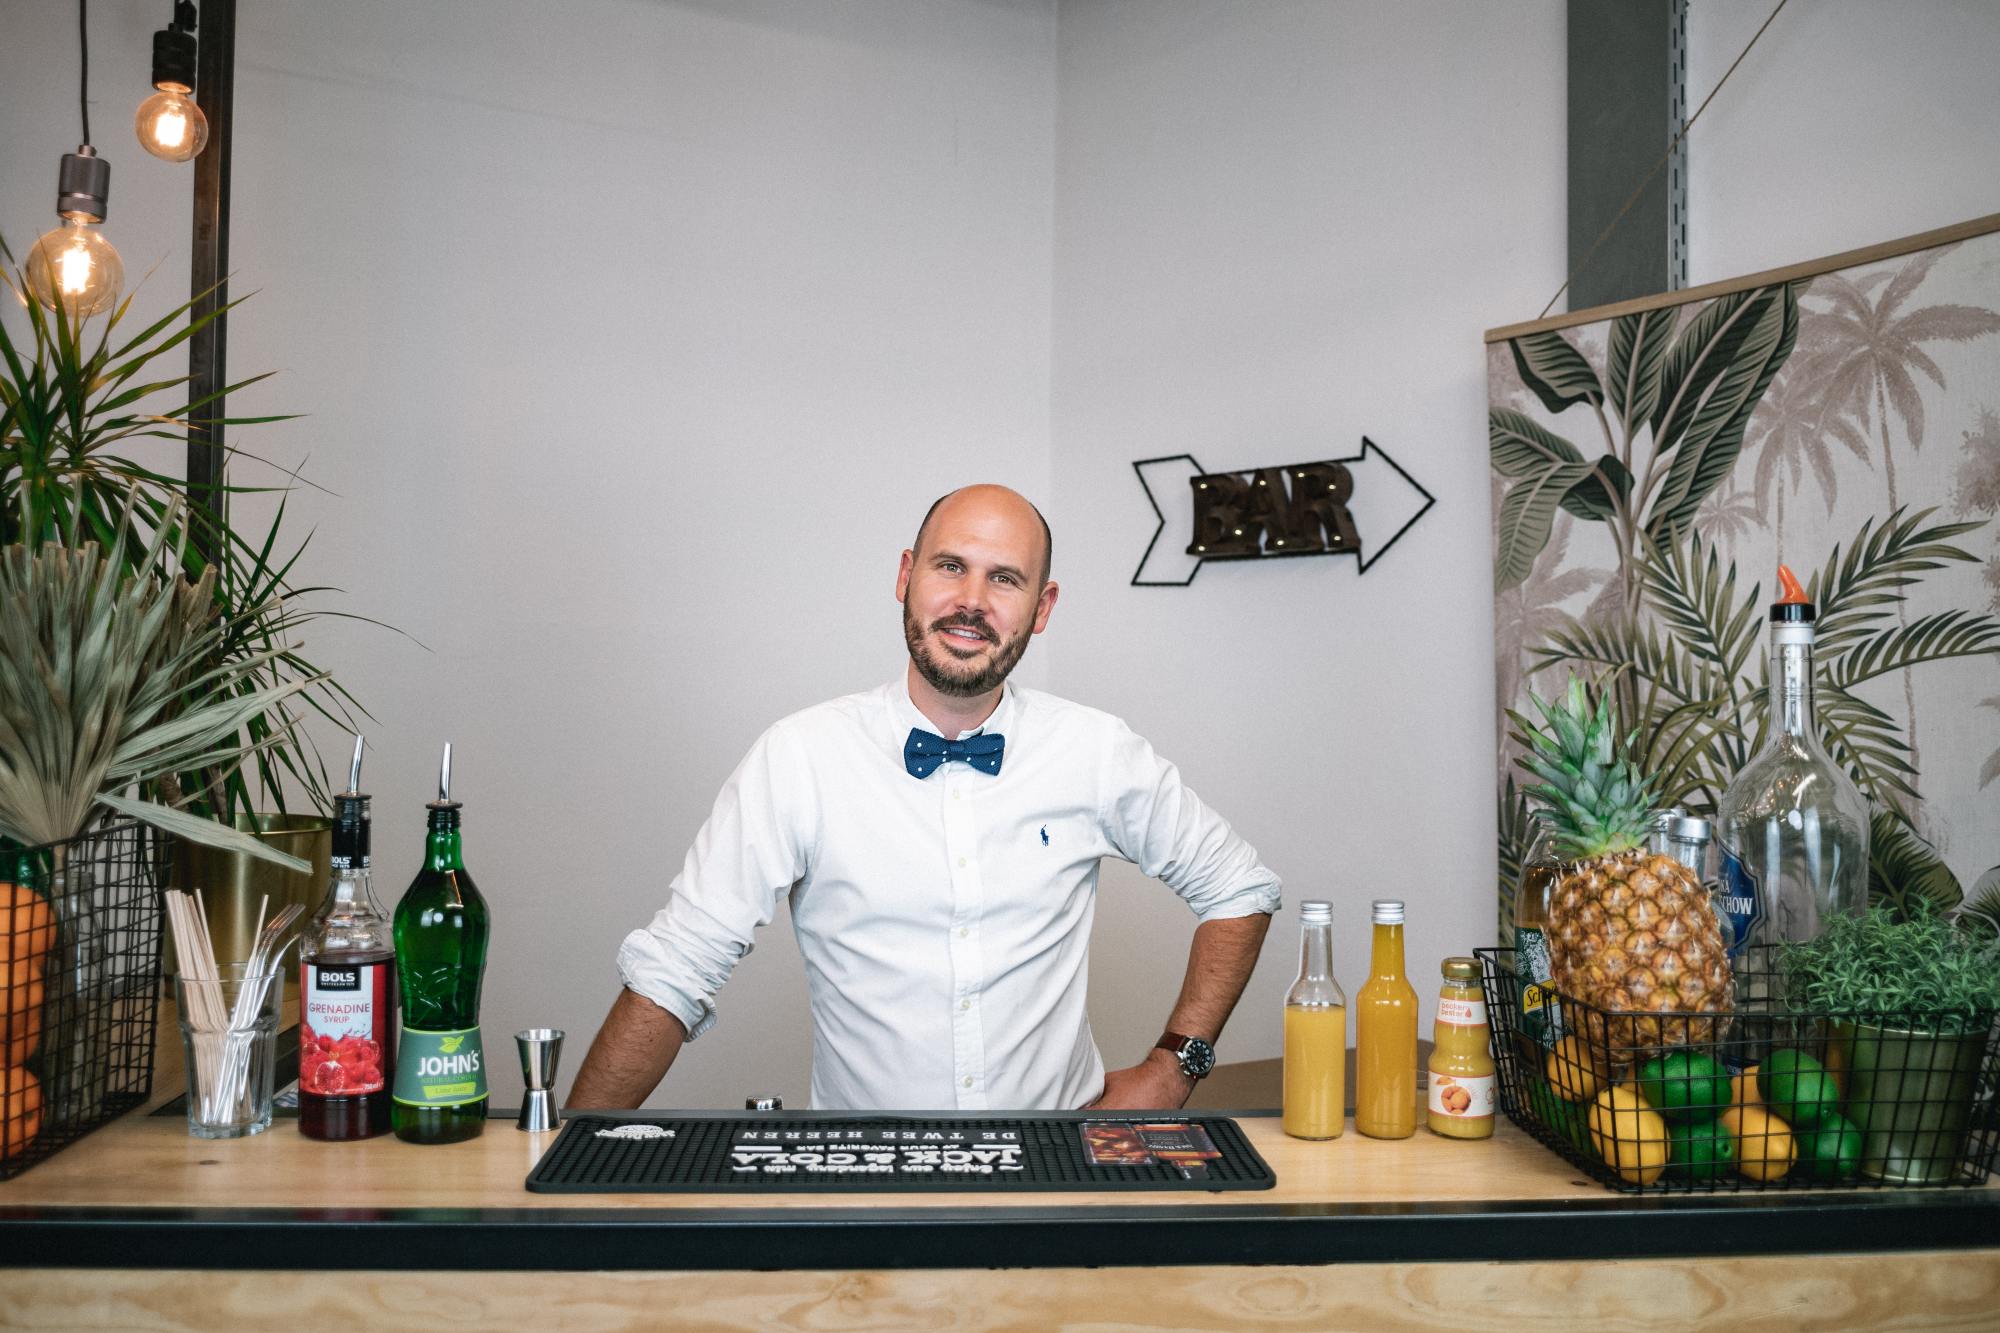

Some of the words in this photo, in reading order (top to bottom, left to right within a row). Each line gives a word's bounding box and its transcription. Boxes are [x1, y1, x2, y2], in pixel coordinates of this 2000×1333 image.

[1186, 461, 1362, 557] BAR
[321, 972, 355, 982] BOLS
[308, 1002, 370, 1014] GRENADINE
[323, 1015, 350, 1024] SYRUP
[417, 1051, 479, 1075] JOHN'S
[741, 1131, 863, 1140] HEEREN
[882, 1131, 964, 1140] TWEE
[982, 1132, 1016, 1140] DE
[731, 1152, 857, 1165] COLA
[863, 1153, 897, 1164] &
[904, 1149, 1022, 1164] JACK
